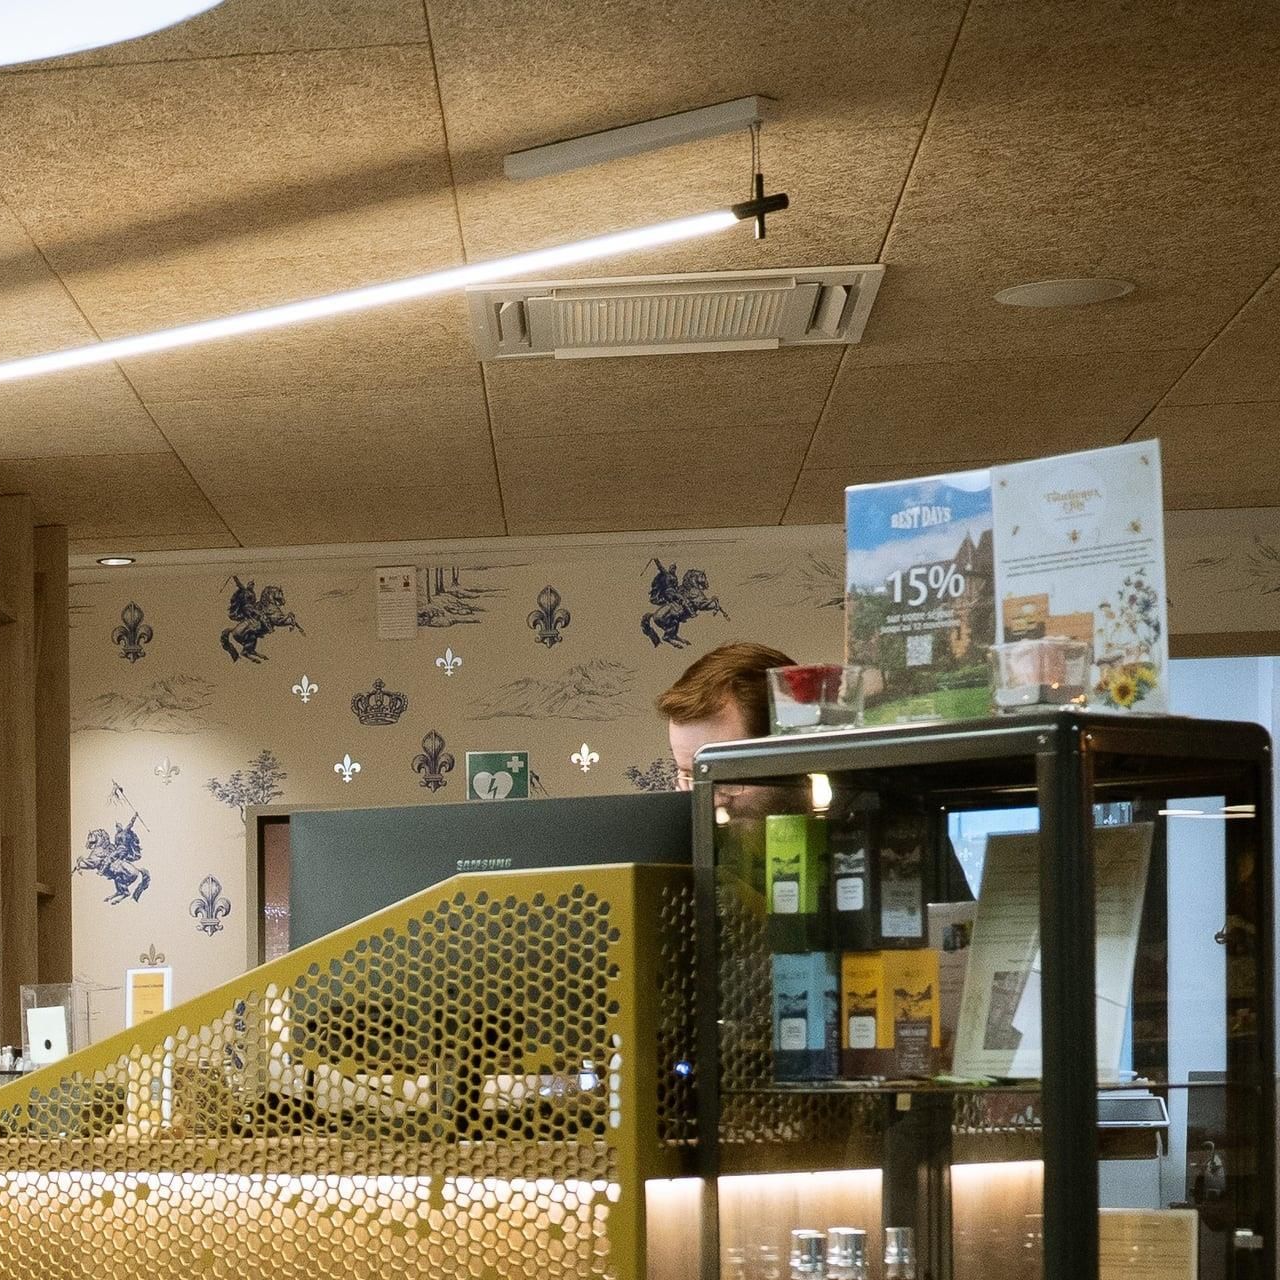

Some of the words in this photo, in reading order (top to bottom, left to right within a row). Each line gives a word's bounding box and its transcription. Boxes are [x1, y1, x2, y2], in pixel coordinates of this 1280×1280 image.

[891, 506, 920, 529] BEST
[922, 506, 952, 527] DAYS
[873, 563, 965, 607] -15%
[456, 858, 512, 871] SAMSUNG
